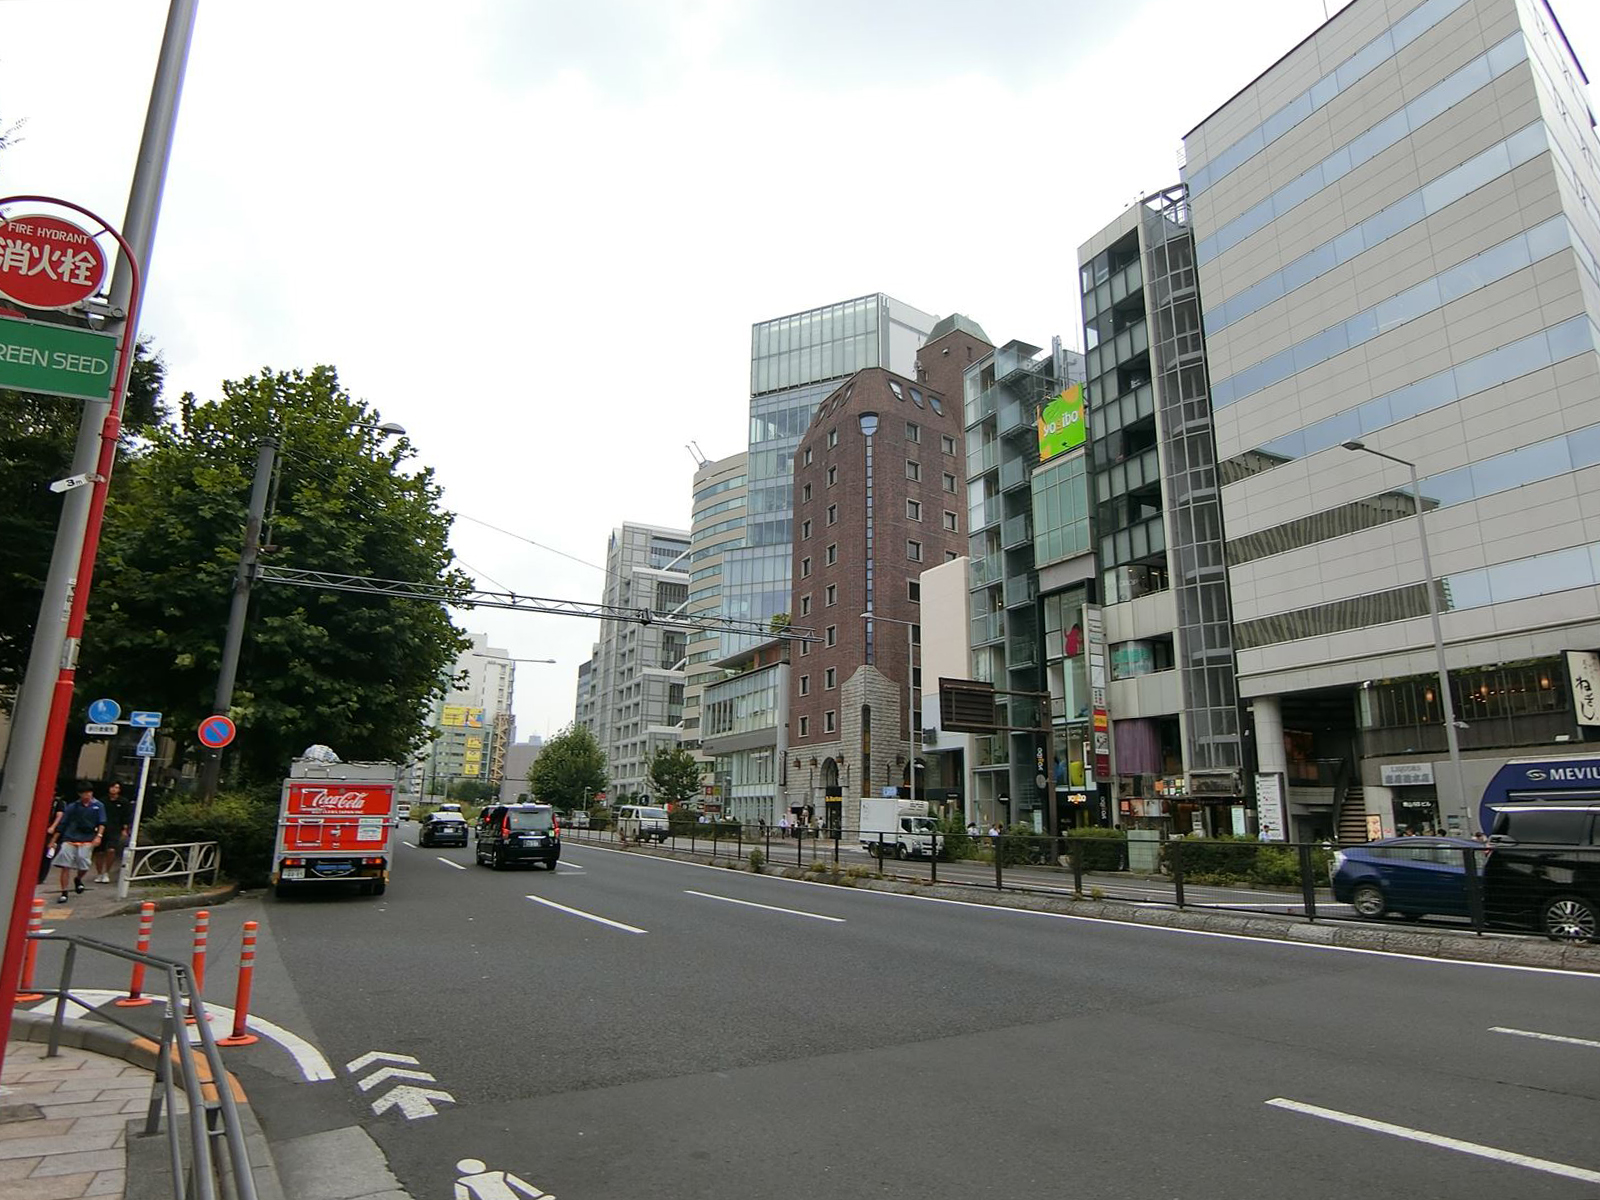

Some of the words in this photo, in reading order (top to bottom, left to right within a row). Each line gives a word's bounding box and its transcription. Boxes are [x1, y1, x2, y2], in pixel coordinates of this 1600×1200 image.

[8, 222, 34, 236] FIRE
[37, 227, 89, 245] HYDRANT
[0, 236, 97, 286] 消火栓
[52, 352, 109, 375] SEED
